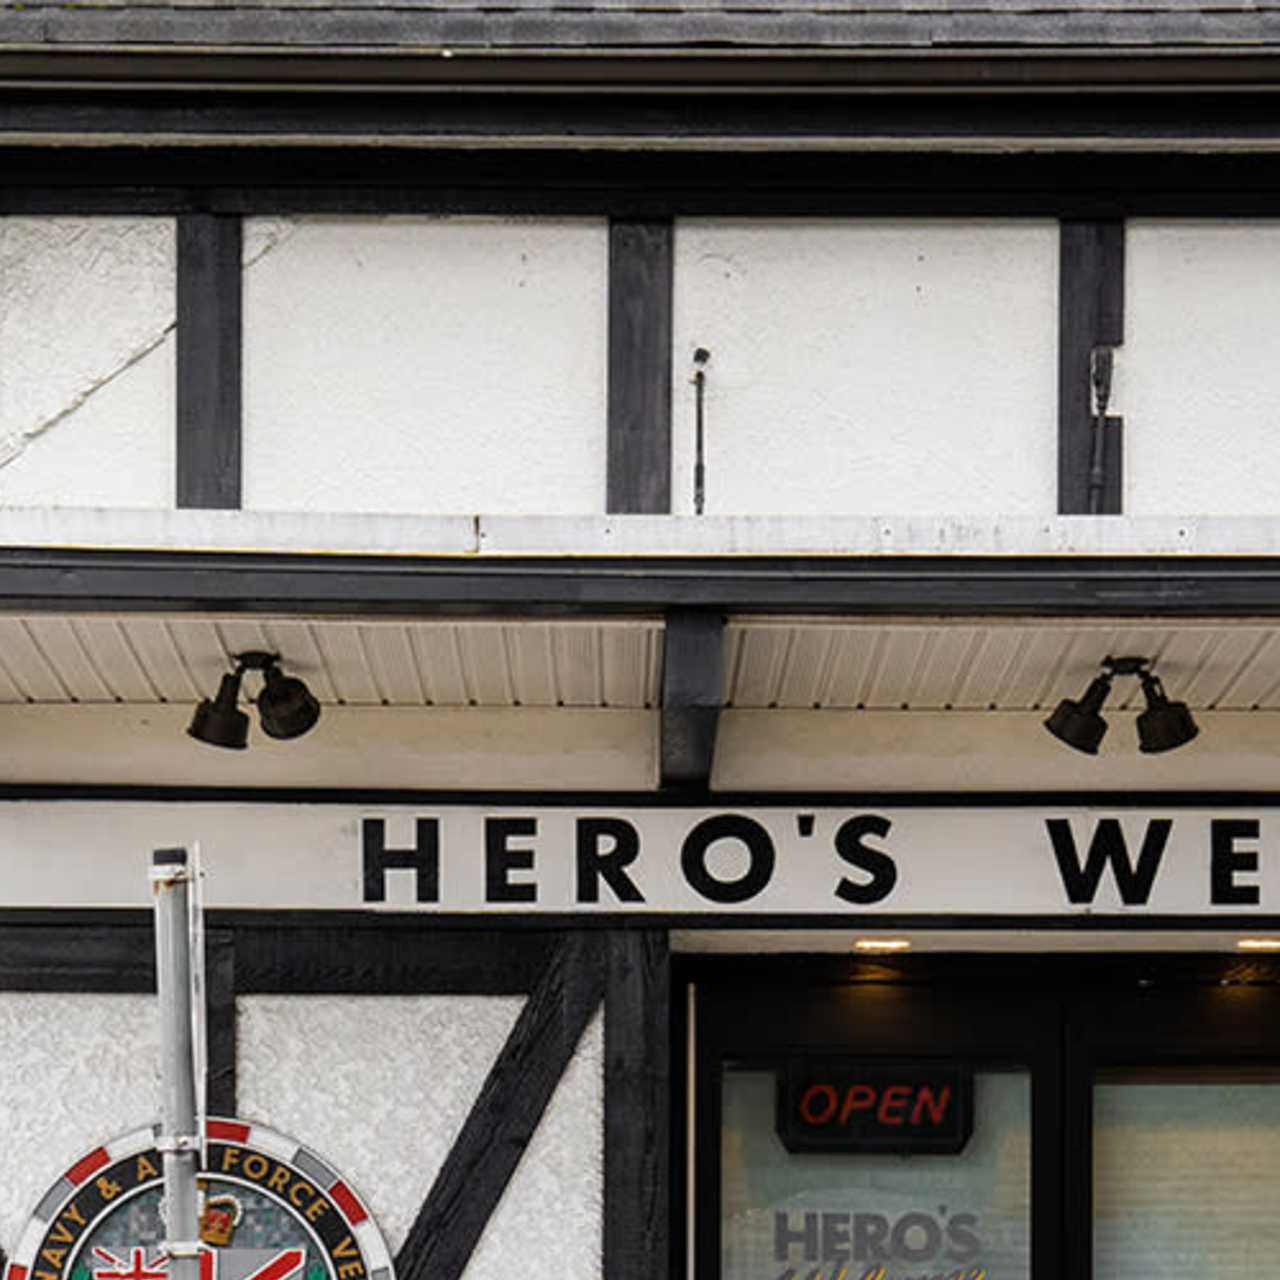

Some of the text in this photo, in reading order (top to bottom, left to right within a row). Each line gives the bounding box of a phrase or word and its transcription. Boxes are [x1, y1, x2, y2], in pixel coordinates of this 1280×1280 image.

[362, 814, 898, 904] HERO'S
[799, 1084, 951, 1126] OPEN
[96, 1177, 122, 1200] &
[223, 1147, 330, 1222] FORCE
[774, 1204, 985, 1264] HERO'S
